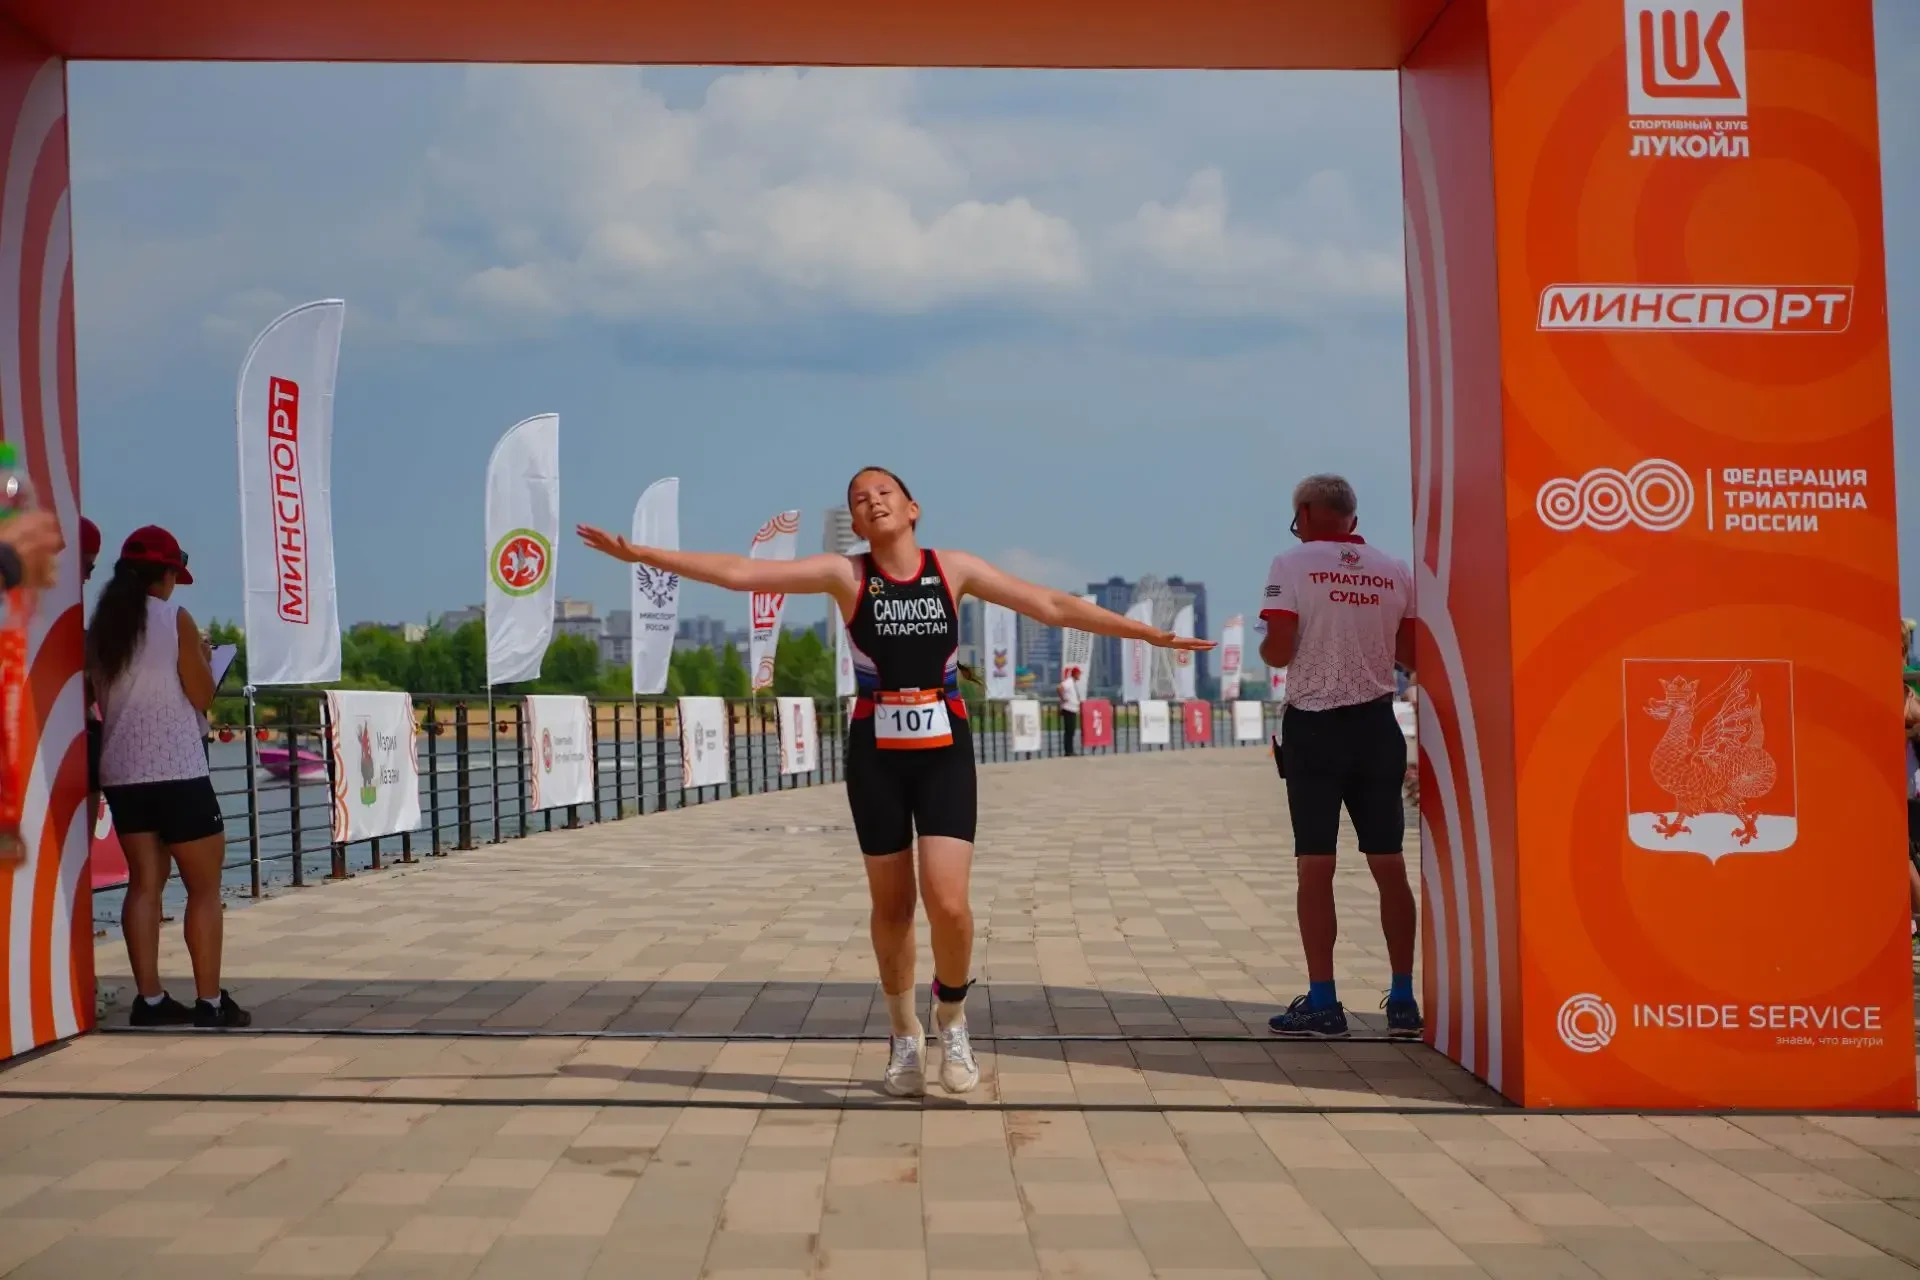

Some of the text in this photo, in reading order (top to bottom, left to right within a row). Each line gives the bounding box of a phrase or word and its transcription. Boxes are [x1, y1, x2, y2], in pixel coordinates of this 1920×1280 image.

[1628, 118, 1748, 131] СПОРТИВНЫЙ КЛУБ
[1629, 131, 1749, 158] ЛУКОЙЛ
[1549, 292, 1847, 325] МИНСПОРТ
[1723, 468, 1868, 488] ФЕДЕРАЦИЯ
[272, 381, 303, 616] МИНСПОРТ
[1724, 491, 1868, 509] ТРИАТЛОНА
[1725, 513, 1819, 532] РОССИИ
[1309, 572, 1394, 589] ТРИАТЛОН
[1329, 590, 1380, 605] СУДЬЯ
[874, 598, 947, 621] САЛИХОВА
[875, 622, 948, 636] ТАТАРСТАН
[891, 708, 934, 732] 107
[1633, 1004, 1882, 1030] INSIDE SERVICE
[1776, 1036, 1884, 1049] знаем, что внутри
